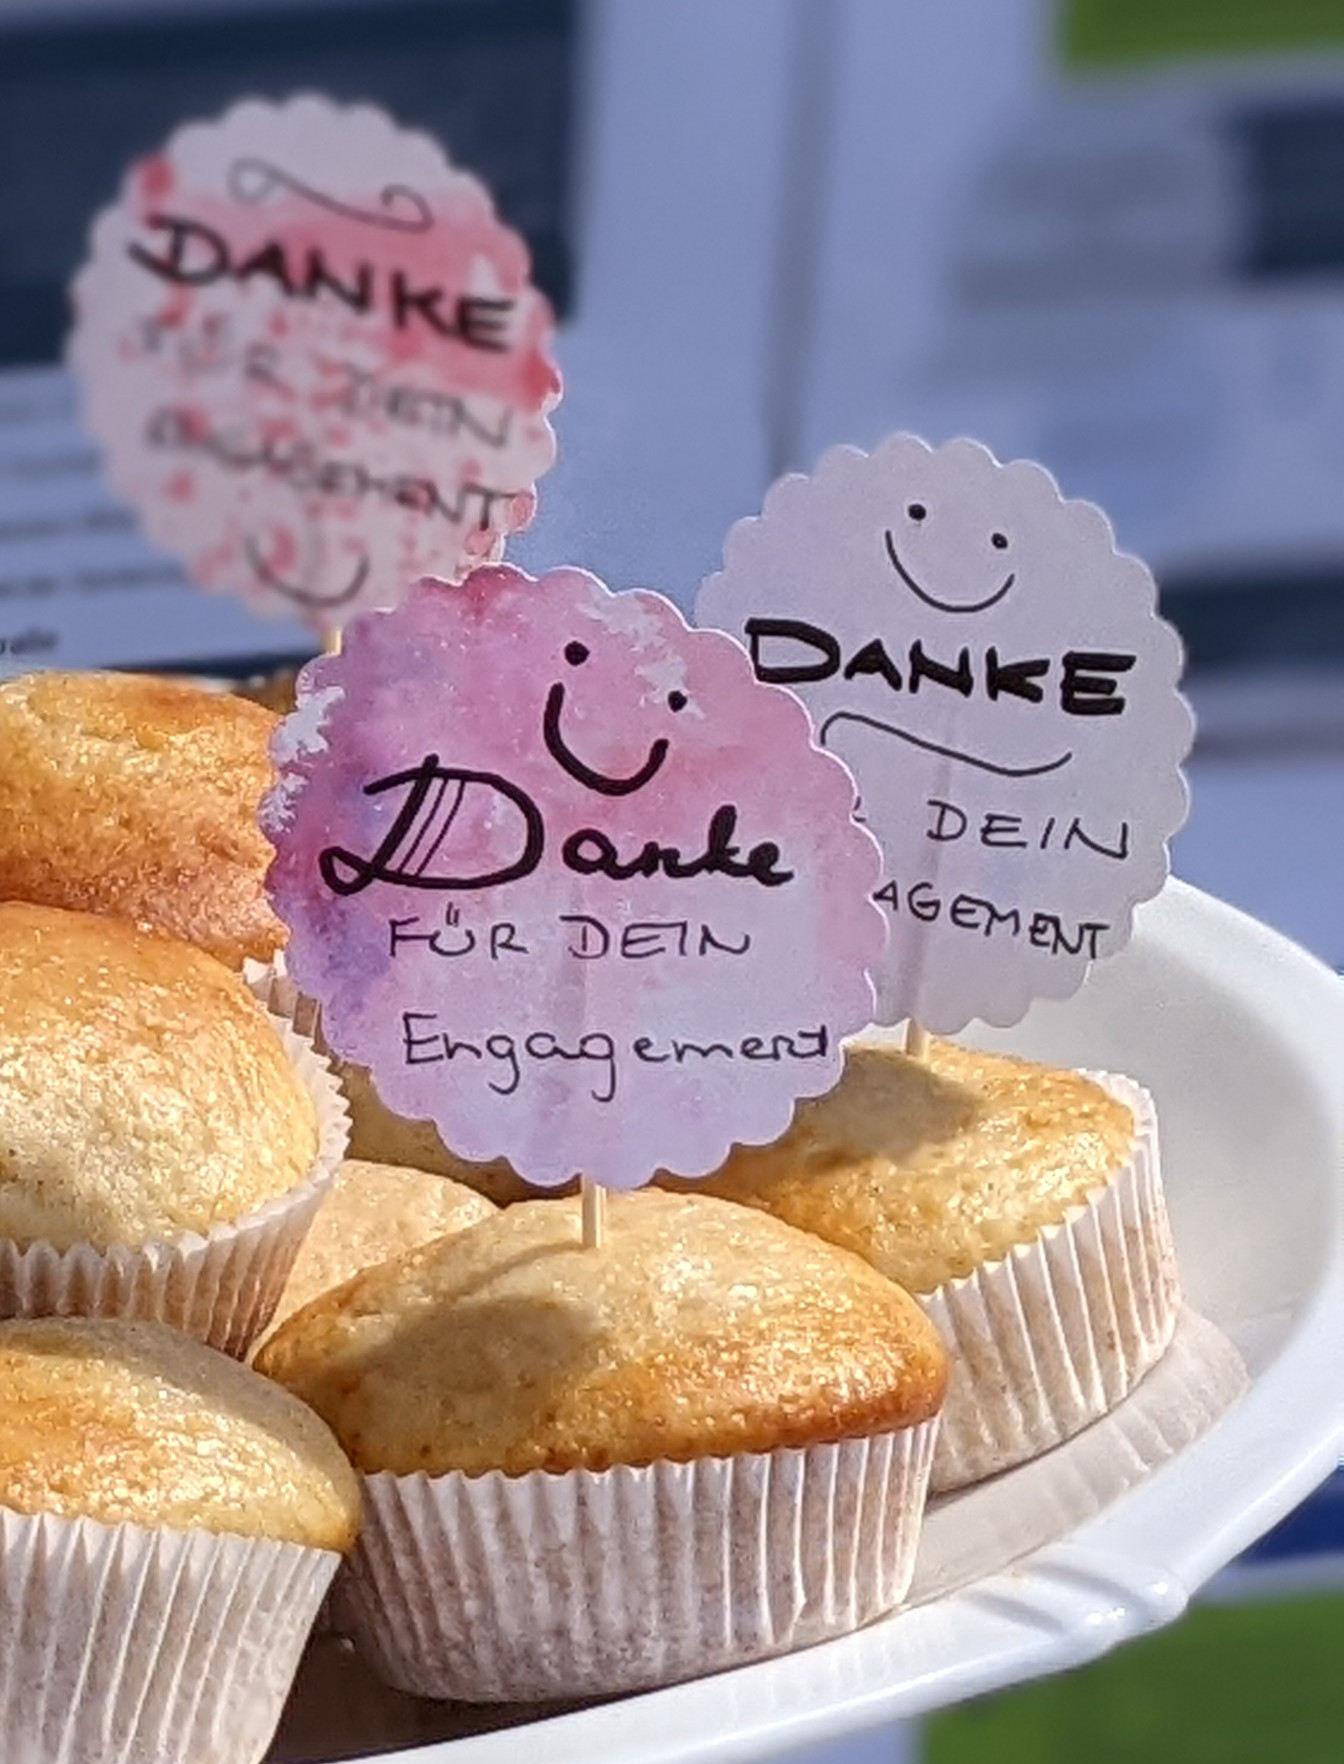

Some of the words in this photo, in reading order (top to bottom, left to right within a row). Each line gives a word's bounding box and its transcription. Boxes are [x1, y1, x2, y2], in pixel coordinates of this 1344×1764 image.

[127, 211, 515, 354] DANKE
[745, 617, 1137, 715] DANKE
[319, 755, 795, 896] Danke
[926, 799, 1129, 862] DEIN
[388, 903, 529, 958] FÜR
[559, 915, 751, 959] DEIN
[871, 879, 1110, 959] AGEMENT
[402, 1012, 828, 1103] Engagement
